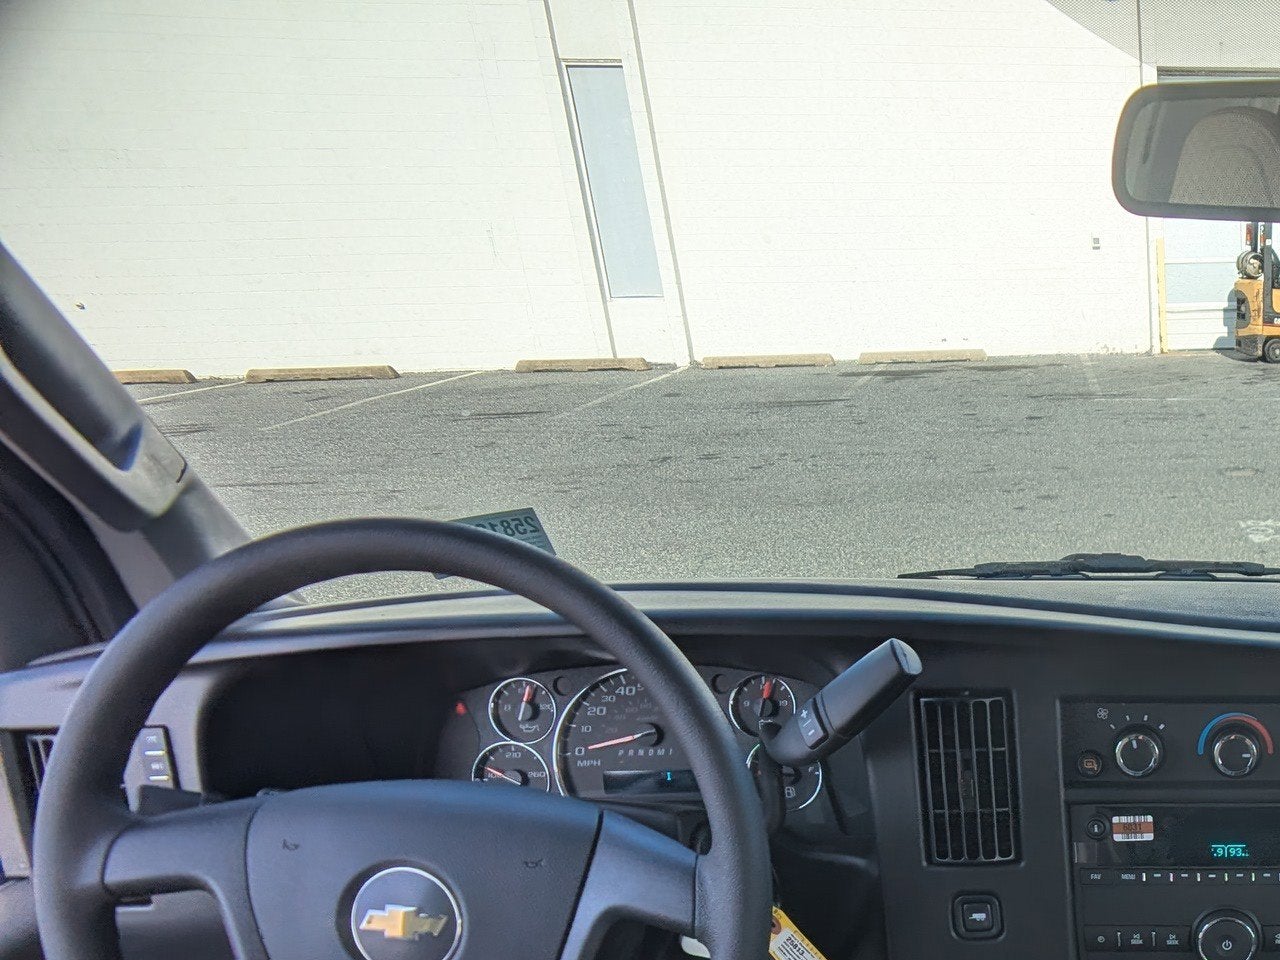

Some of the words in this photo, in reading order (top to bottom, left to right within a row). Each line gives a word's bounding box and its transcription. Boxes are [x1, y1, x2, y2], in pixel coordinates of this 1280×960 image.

[615, 686, 636, 696] 40
[587, 707, 606, 716] 20
[574, 747, 585, 756] 0
